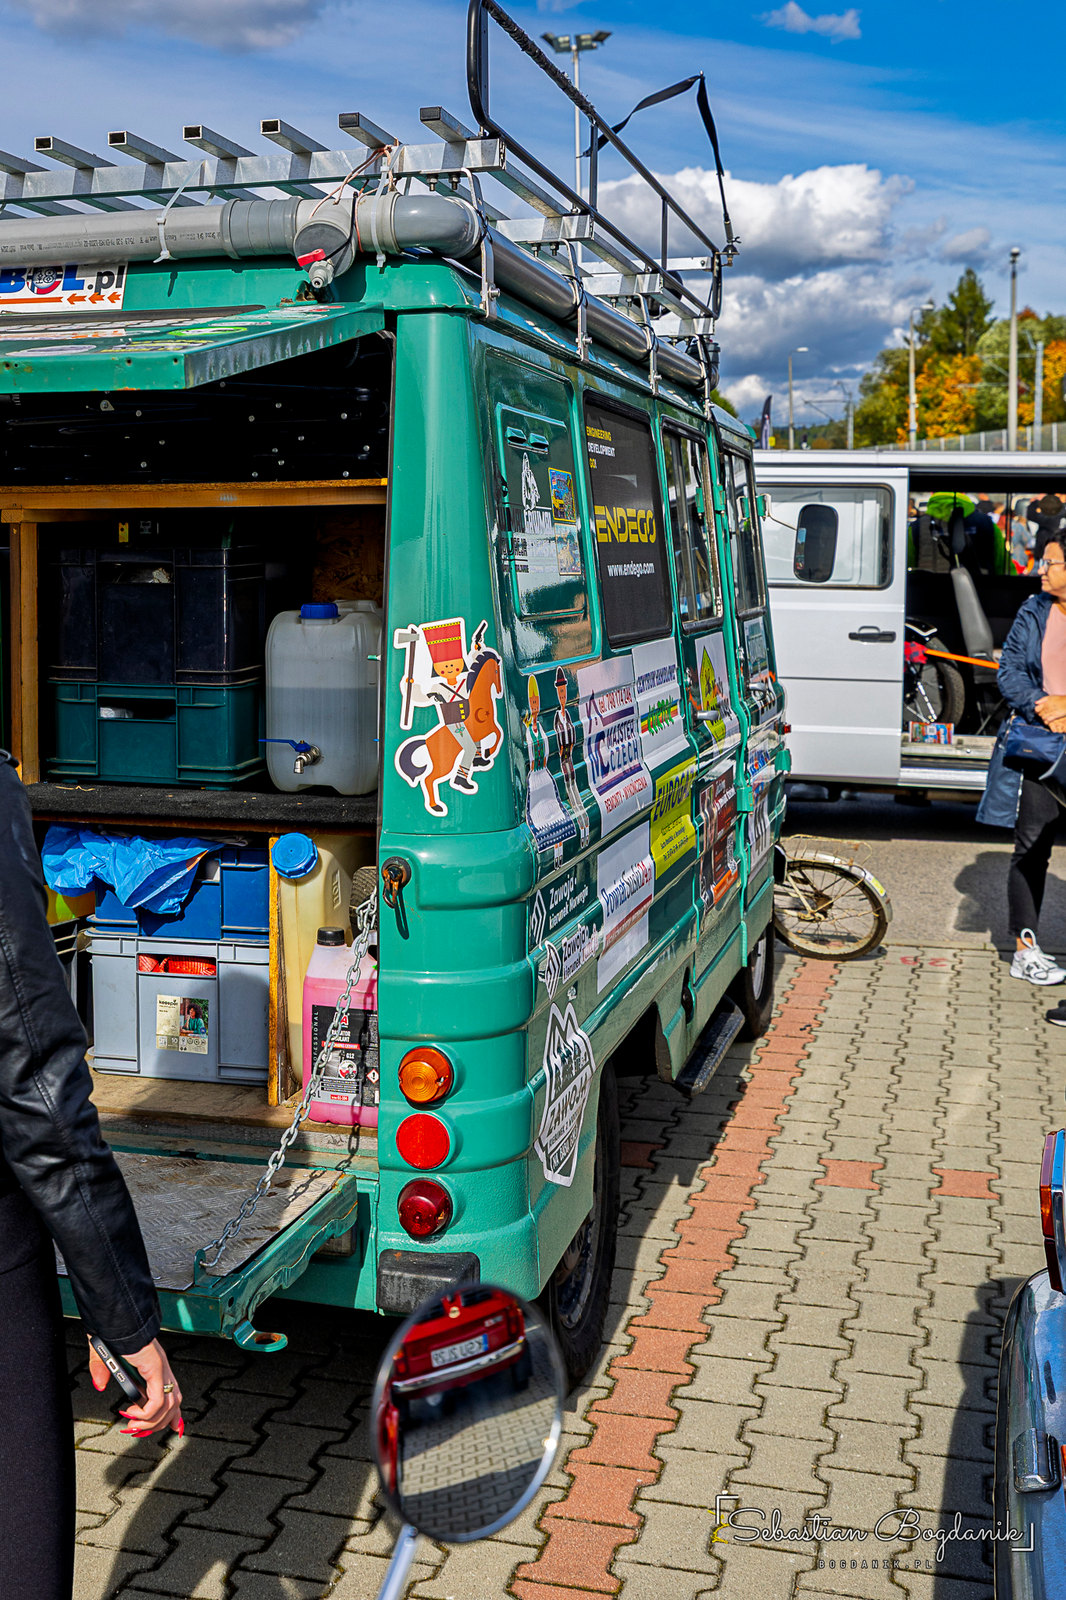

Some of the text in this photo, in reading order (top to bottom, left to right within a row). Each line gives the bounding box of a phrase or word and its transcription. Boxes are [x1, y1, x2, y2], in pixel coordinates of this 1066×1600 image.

[586, 426, 612, 442] ENGINEERING
[587, 441, 616, 457] DEVELOPMENT
[594, 505, 657, 543] ENDEGO
[607, 560, 655, 578] www.endego.com
[606, 718, 637, 749] MAJSTER
[609, 738, 640, 773] CZECH
[549, 874, 574, 911] Zawoja
[562, 927, 588, 963] Zawoja
[547, 1073, 589, 1138] ZAWOJA
